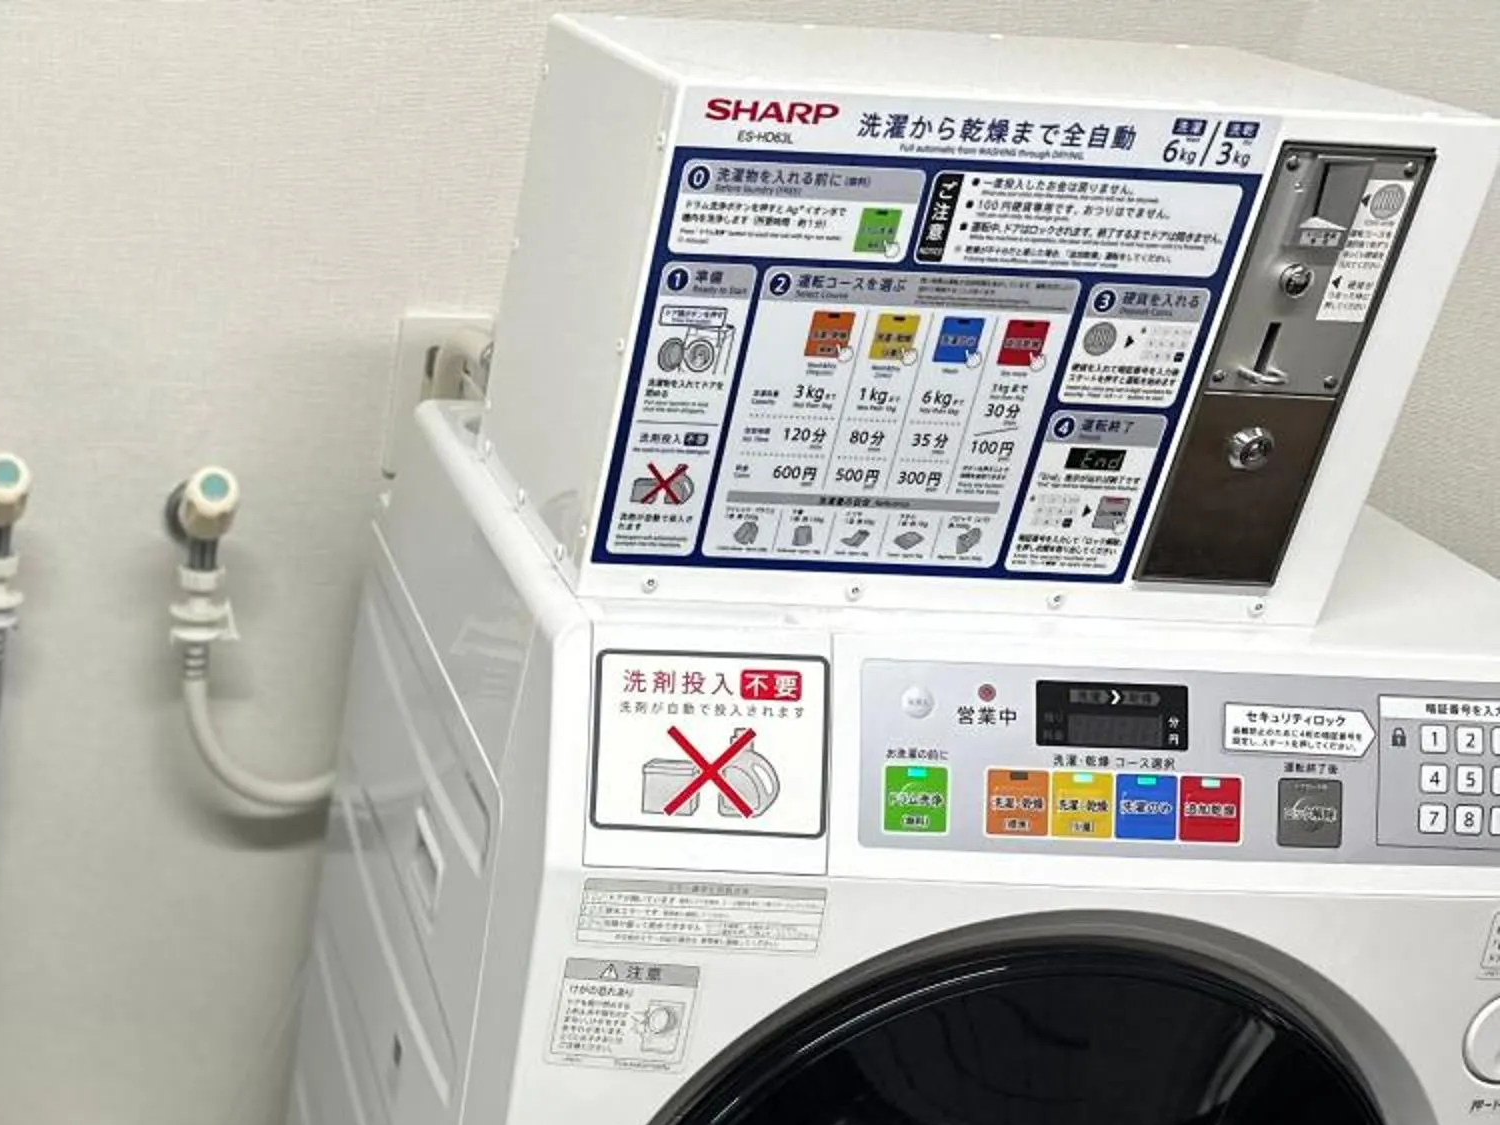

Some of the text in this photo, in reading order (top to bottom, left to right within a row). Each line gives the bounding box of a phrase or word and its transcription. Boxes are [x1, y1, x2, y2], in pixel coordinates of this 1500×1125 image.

[705, 97, 840, 125] SHARP
[856, 112, 1138, 152] 洗濯から乾燥まで全自動
[1162, 138, 1198, 165] 6kg
[1215, 141, 1251, 167] 3kg
[716, 167, 844, 186] 洗濯物を入れる前に
[794, 384, 825, 404] 3kg
[921, 390, 952, 409] 6kg
[984, 403, 1021, 419] 30分
[783, 427, 827, 444] 120分
[849, 430, 885, 447] 80分
[911, 433, 949, 449] 35分
[970, 440, 1015, 457] 100円
[772, 465, 818, 482] 600円
[835, 467, 880, 485] 500円
[898, 470, 943, 487] 300円
[623, 668, 798, 699] 洗剤投入 不要
[619, 700, 806, 719] 洗剤が自動で投入されます
[956, 706, 1019, 727] 営業中
[1245, 710, 1347, 728] セキュリティロック
[1114, 757, 1177, 771] コース選択
[1429, 771, 1440, 786] 4
[1429, 811, 1440, 826] 7
